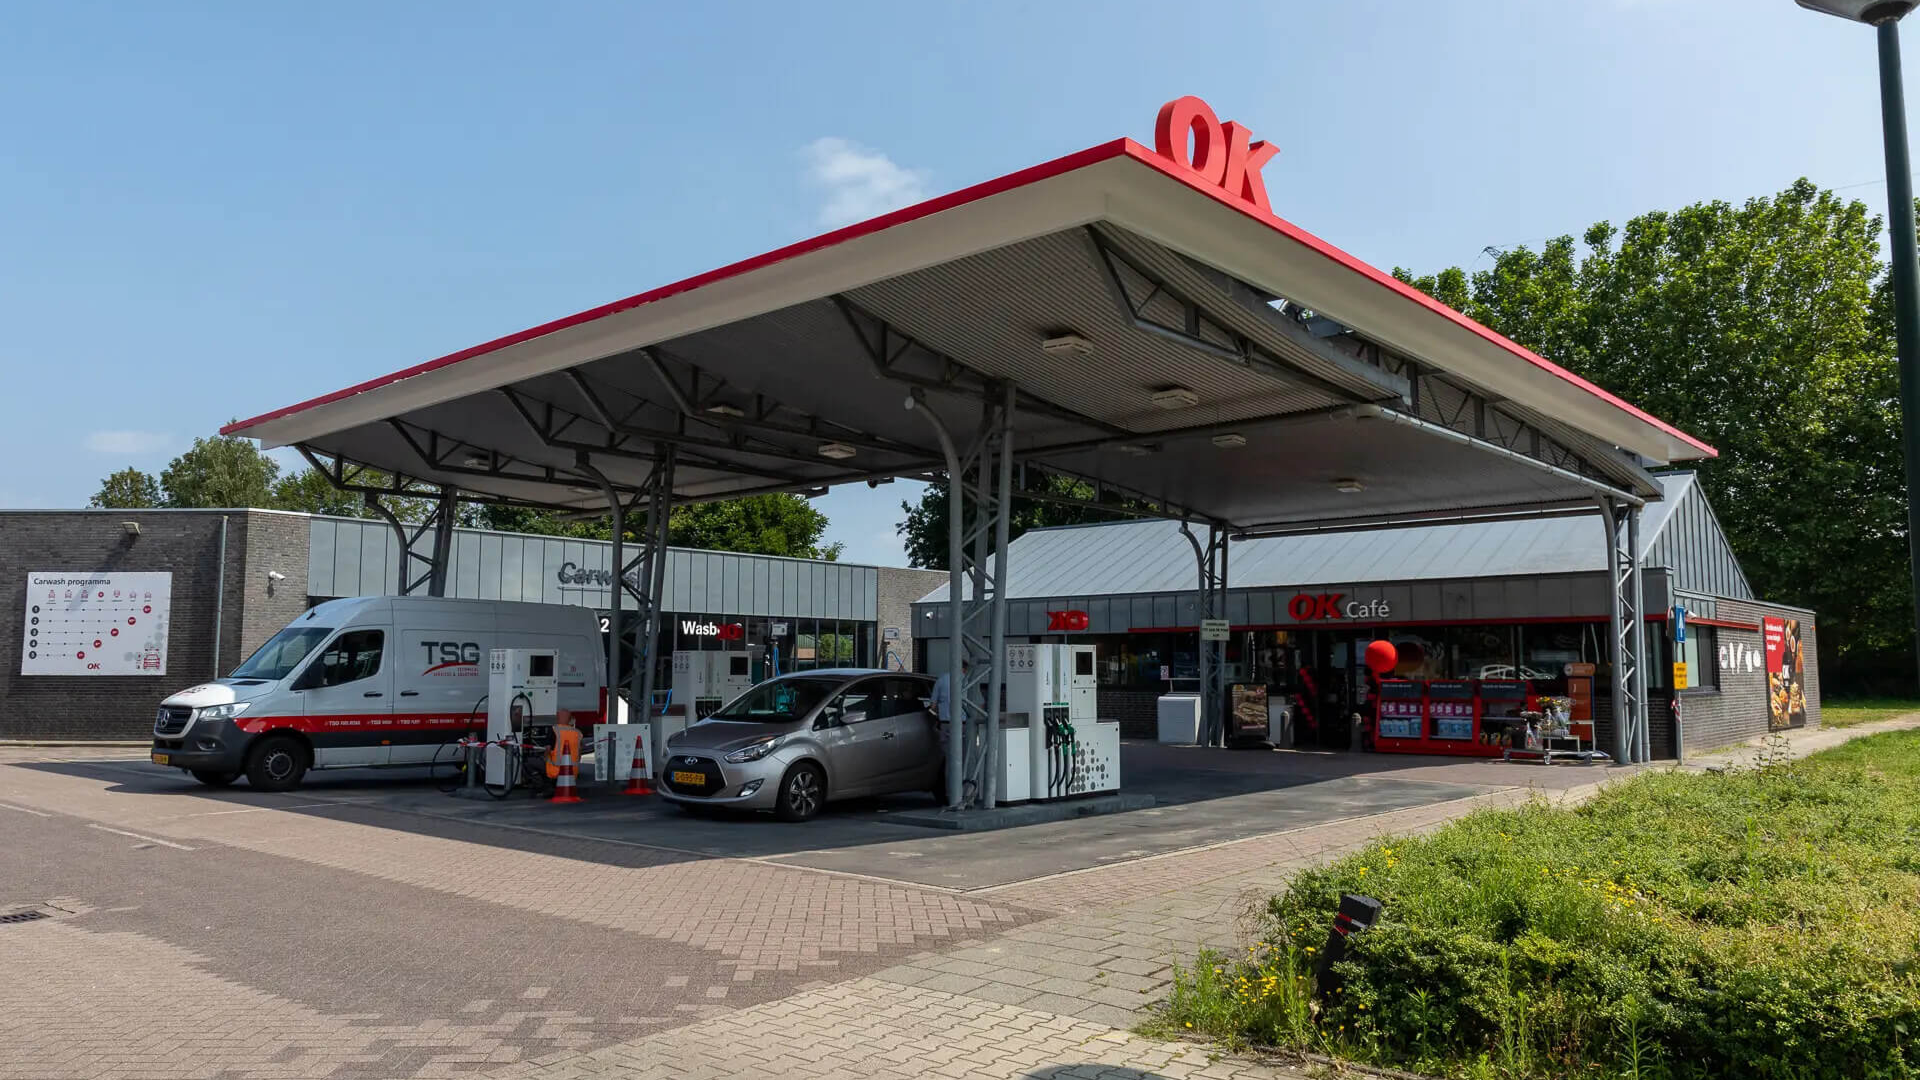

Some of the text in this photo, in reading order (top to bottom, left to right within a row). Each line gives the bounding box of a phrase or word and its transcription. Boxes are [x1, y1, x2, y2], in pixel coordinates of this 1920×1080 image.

[1155, 95, 1281, 214] OK
[67, 579, 111, 587] programma
[1288, 593, 1390, 621] OK Café
[600, 618, 610, 633] 2
[421, 641, 480, 665] TSG
